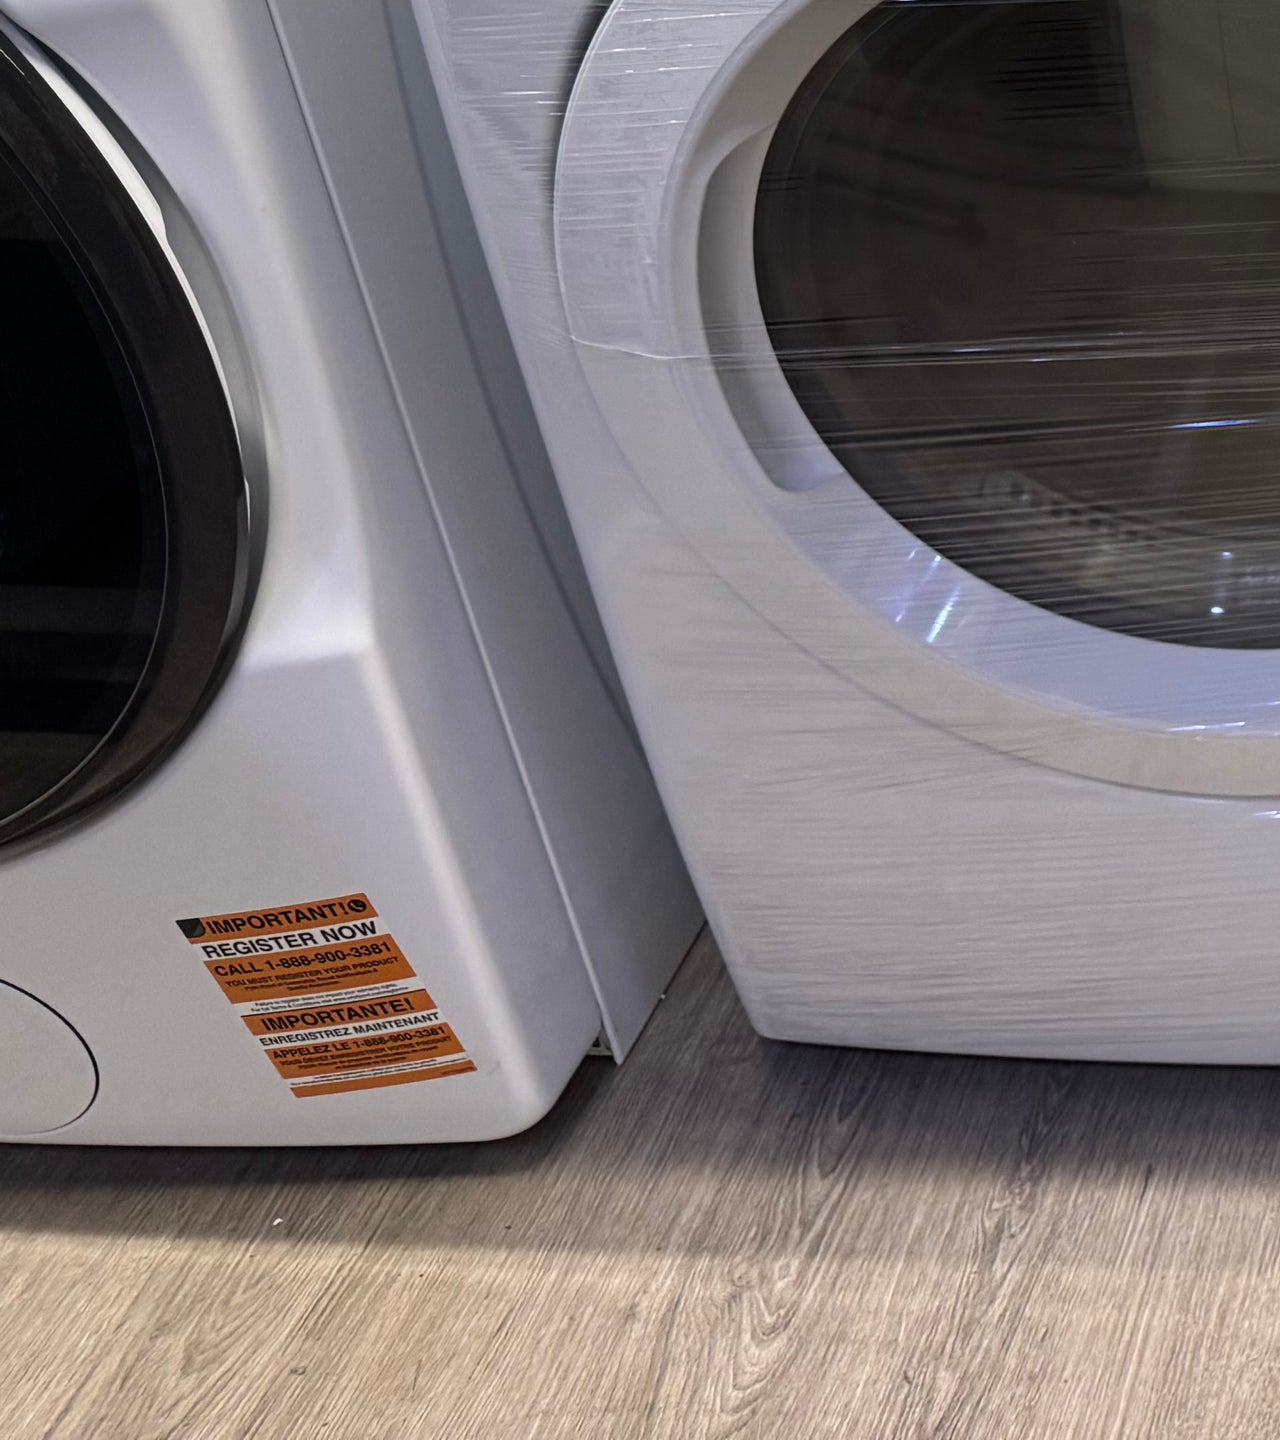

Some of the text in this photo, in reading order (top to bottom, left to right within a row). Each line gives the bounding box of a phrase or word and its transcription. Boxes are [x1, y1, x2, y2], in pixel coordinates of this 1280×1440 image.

[207, 901, 348, 934] IMPORTANT!
[202, 920, 377, 959] REGISTER NOW
[214, 941, 391, 977] CALL 1-888-900-3381
[247, 976, 273, 985] MUST
[274, 970, 322, 981] REGISTER
[323, 965, 351, 974] YOUR
[352, 956, 398, 970] PRODUCT
[259, 1012, 439, 1047] ENREGISTREZ MAINTENANT
[261, 998, 414, 1032] IMPORTANTE!
[273, 1026, 446, 1059] APPELEZ LE 1-888-900-3381
